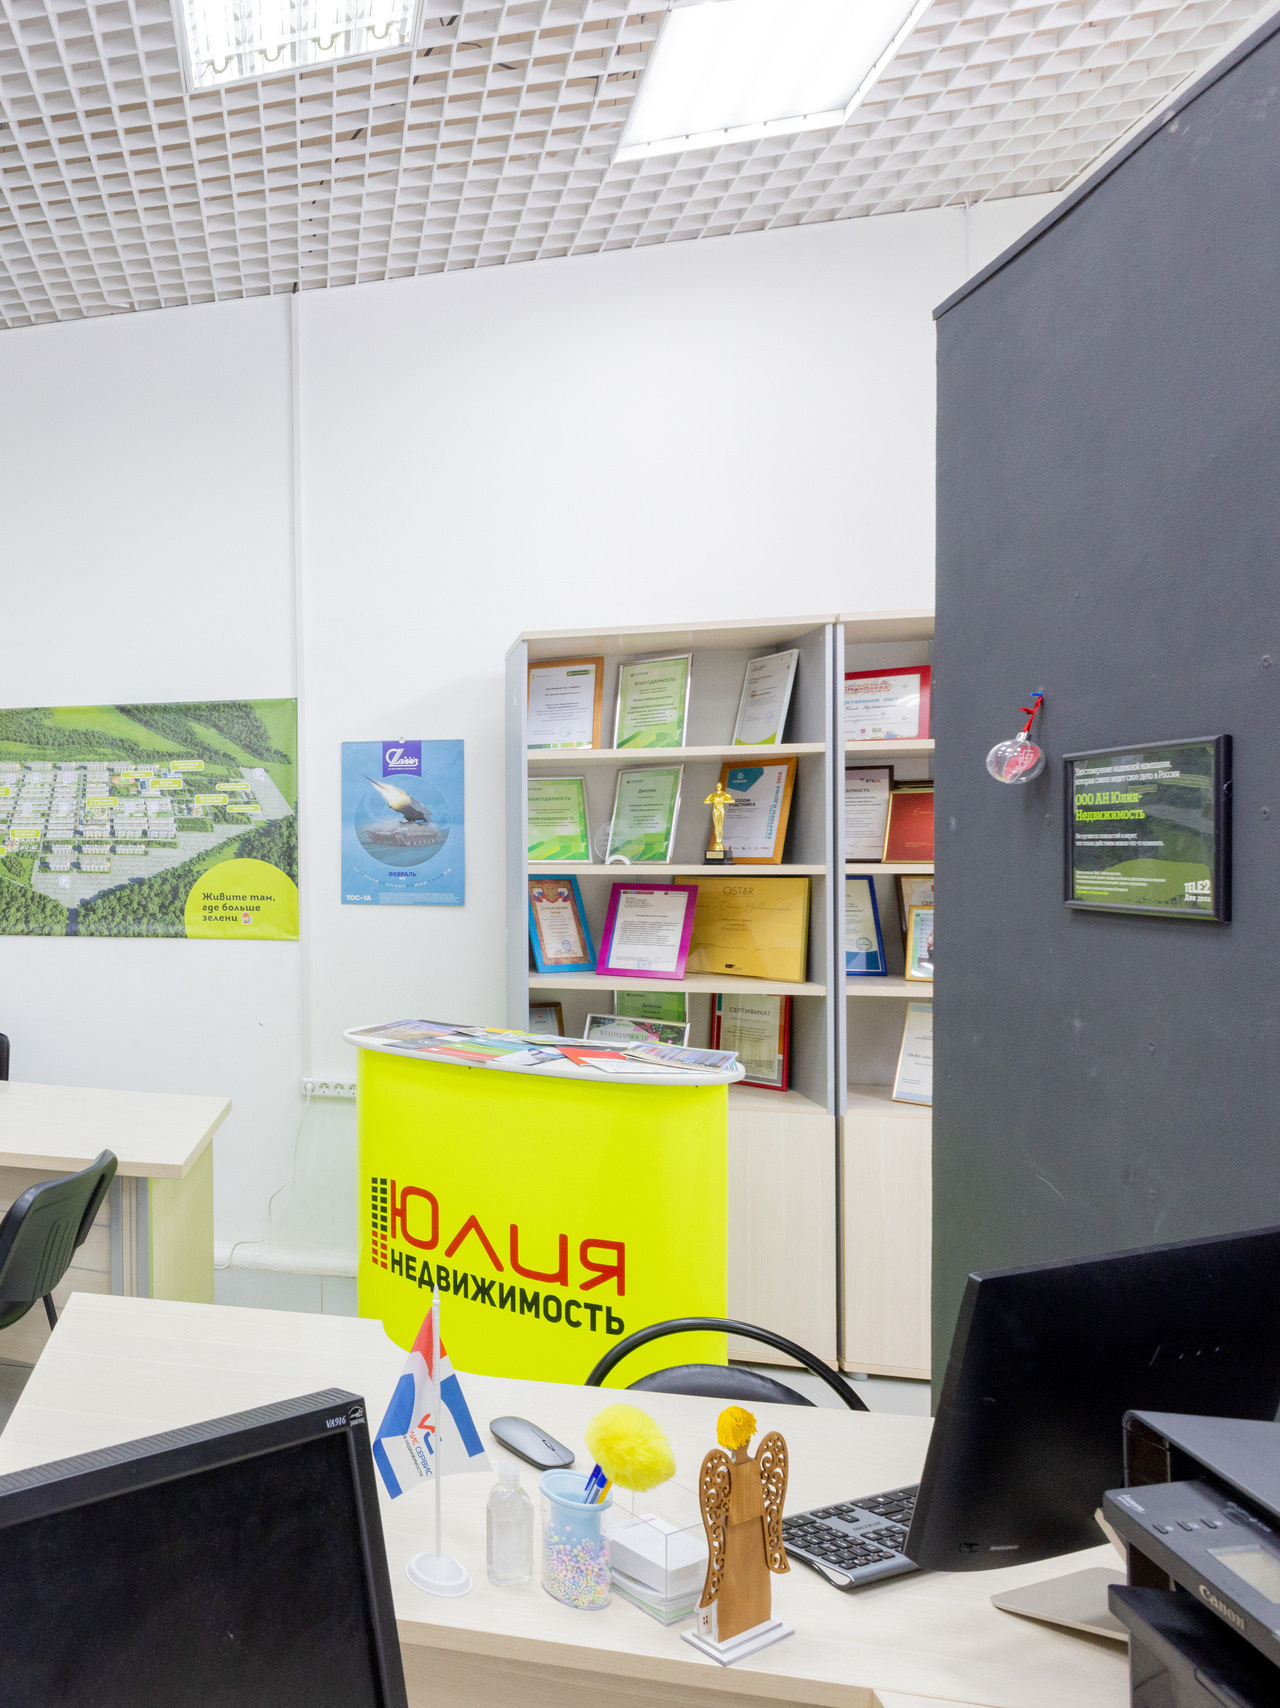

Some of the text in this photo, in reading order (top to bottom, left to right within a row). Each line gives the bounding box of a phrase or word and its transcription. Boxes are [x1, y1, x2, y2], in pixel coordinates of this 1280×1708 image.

[1075, 793, 1095, 805] ООО
[1095, 792, 1110, 804] АН
[1075, 809, 1146, 822] Недвижимость
[1184, 879, 1211, 894] TELE2
[202, 891, 276, 903] Живите там,
[202, 902, 261, 914] где больше
[202, 914, 238, 922] зелени
[729, 1006, 772, 1016] СЕРТИФИКАТ
[390, 1248, 625, 1336] НЕДВИЖИМОСТЬ
[326, 1415, 347, 1429] VA916
[415, 1446, 433, 1477] СЕРВИС
[1199, 1584, 1245, 1631] Canon
